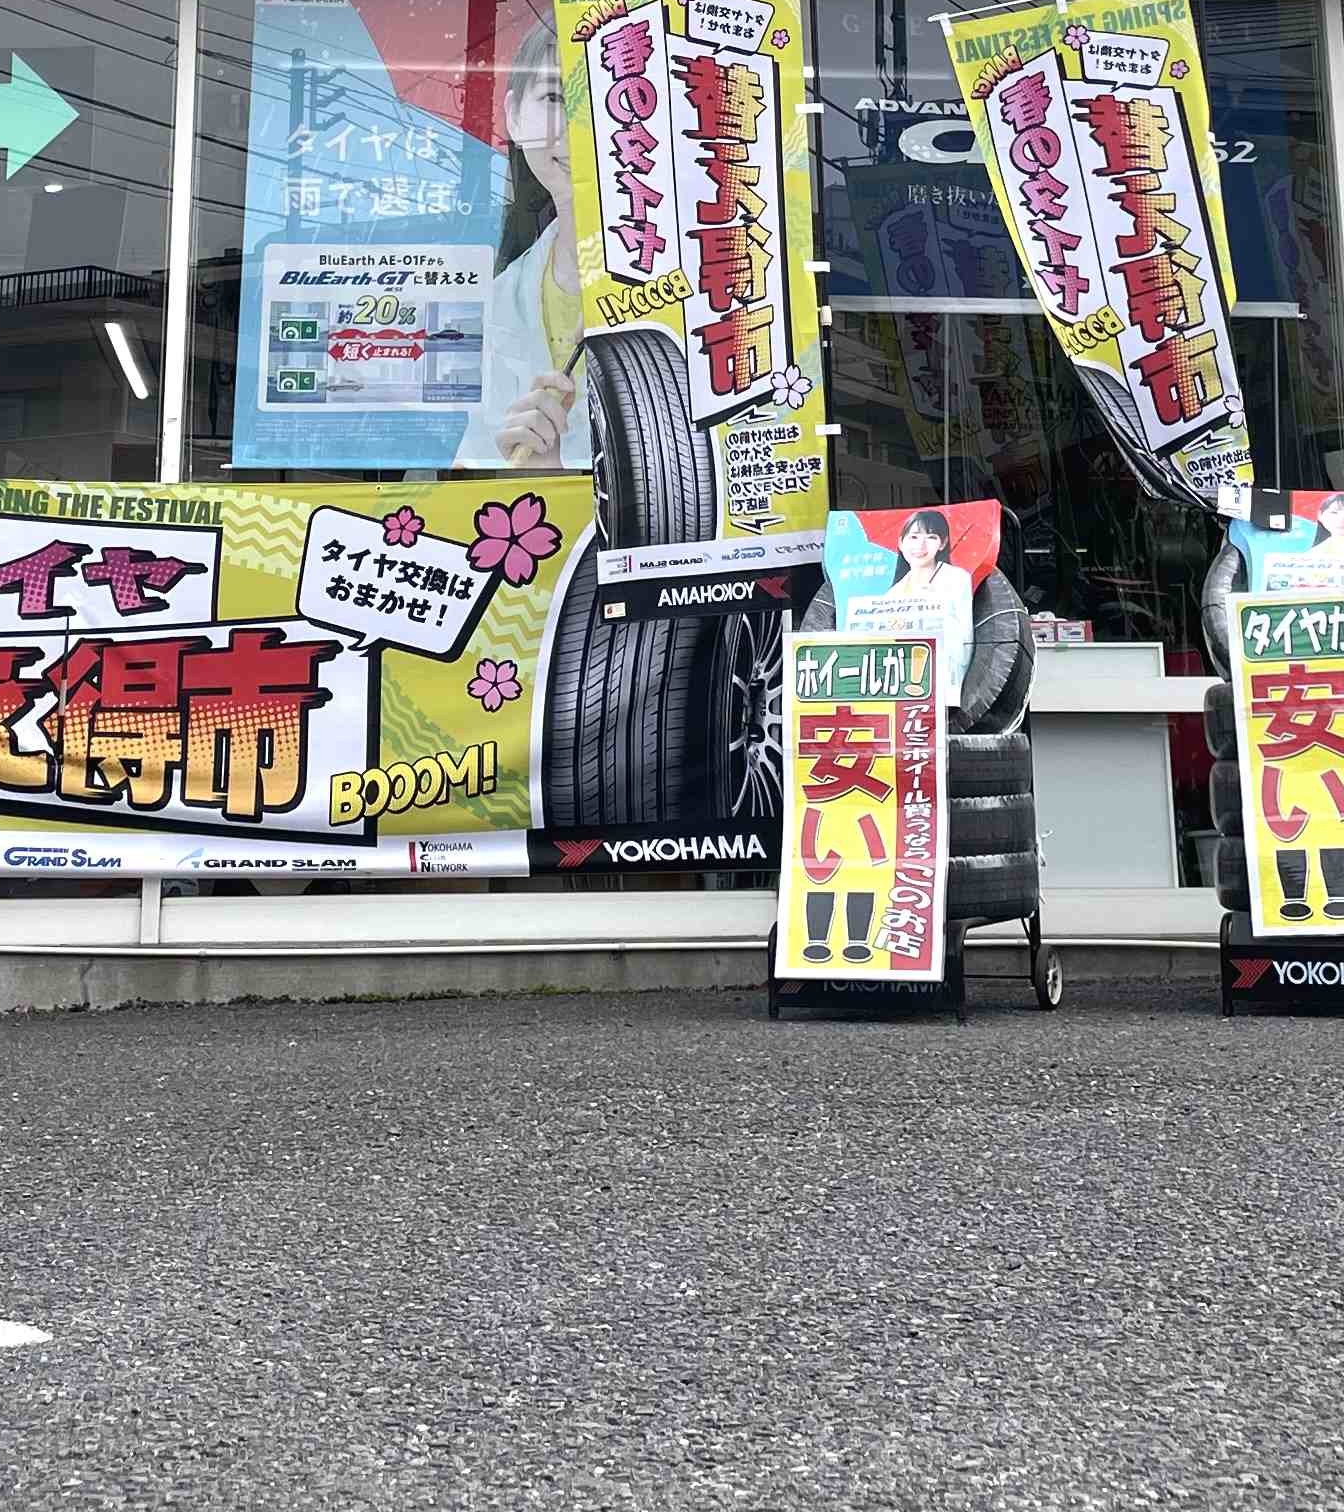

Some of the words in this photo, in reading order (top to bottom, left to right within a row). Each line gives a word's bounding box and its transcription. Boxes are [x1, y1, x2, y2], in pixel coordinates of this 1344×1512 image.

[282, 178, 472, 218] 雨で選ぼ。
[319, 255, 375, 266] BluEarth
[57, 491, 104, 520] THE
[107, 495, 224, 526] FESTIVAL
[321, 537, 474, 601] タイヤ交換は
[329, 741, 498, 826] BOOOM!
[798, 705, 894, 885] 安い
[71, 847, 122, 868] SLAM
[419, 841, 473, 853] YOKOHAMA
[603, 833, 767, 862] YOKOHAMA
[203, 858, 287, 870] GRAND
[290, 858, 357, 871] SLAM
[420, 861, 469, 873] NETWORK
